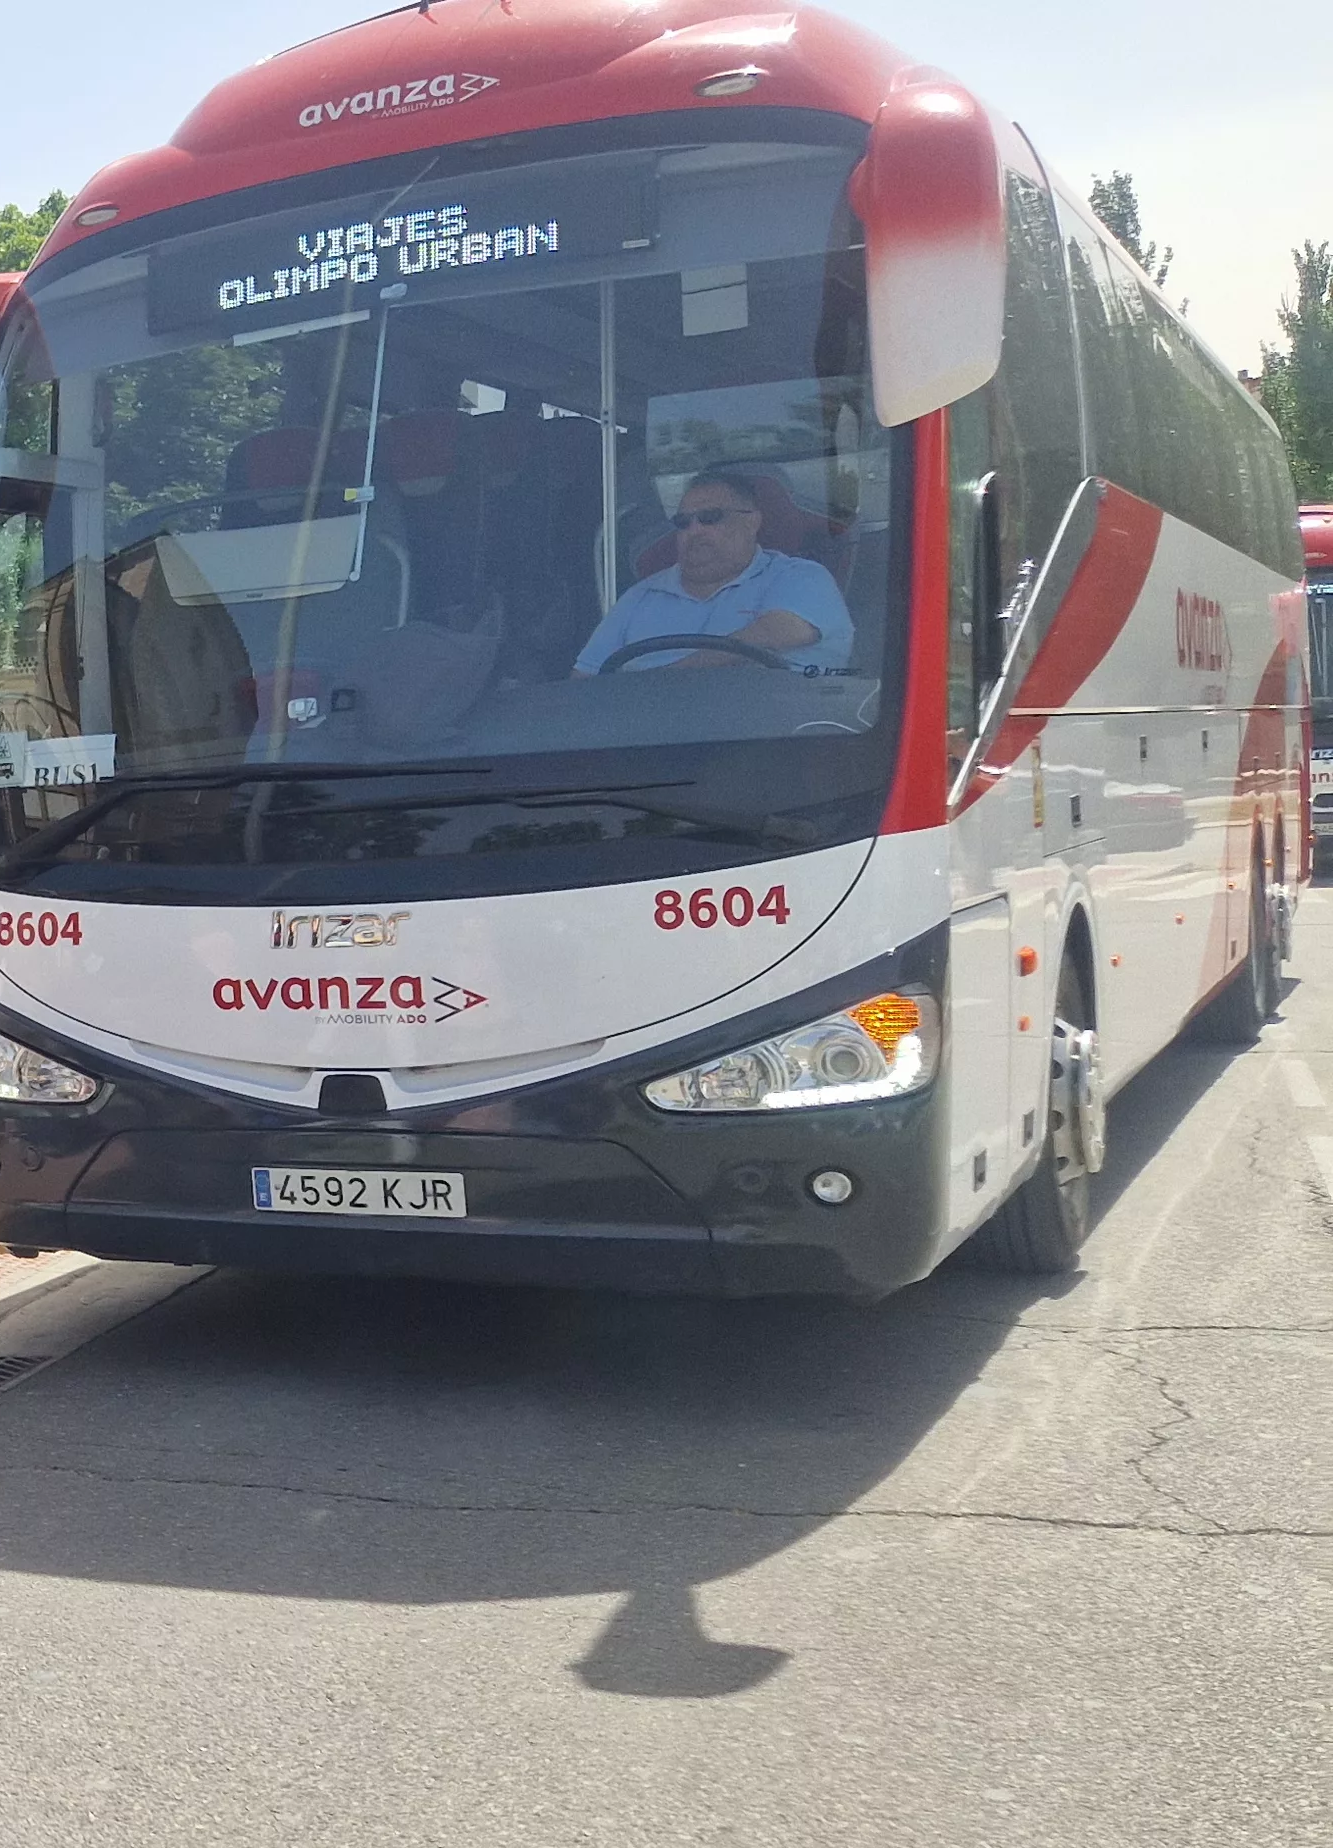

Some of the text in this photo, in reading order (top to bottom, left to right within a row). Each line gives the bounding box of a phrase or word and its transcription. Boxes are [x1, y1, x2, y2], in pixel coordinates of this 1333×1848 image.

[299, 73, 455, 127] avanza
[380, 102, 430, 118] MOBILITY
[432, 96, 455, 108] ADO
[297, 204, 468, 261] VIAJES
[218, 219, 559, 309] OLIMPO URBAN
[653, 884, 791, 930] 8604
[212, 975, 426, 1010] avanza
[326, 1014, 393, 1025] MOBILITY
[396, 1014, 427, 1024] ADO
[279, 1174, 368, 1209] 4592
[382, 1178, 453, 1211] KJR
